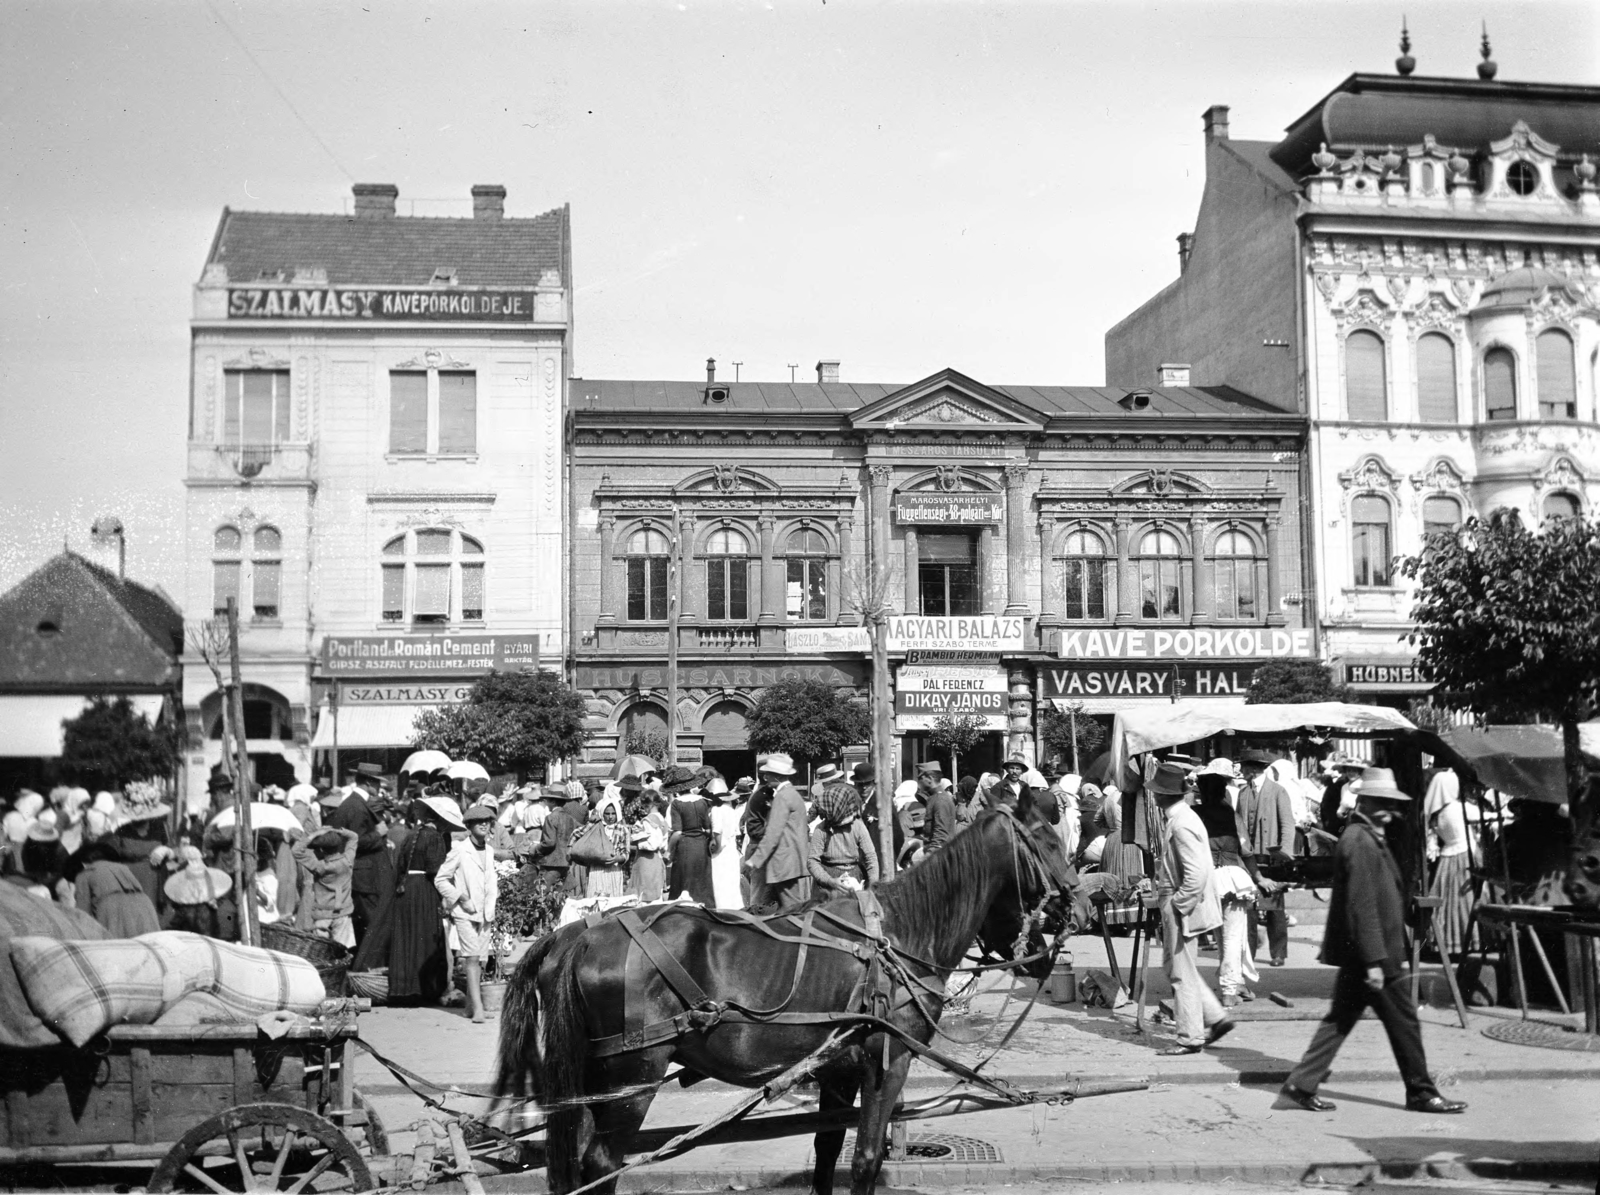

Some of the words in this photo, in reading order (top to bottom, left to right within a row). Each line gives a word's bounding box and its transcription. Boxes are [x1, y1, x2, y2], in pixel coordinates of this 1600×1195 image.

[329, 639, 388, 657] Portland
[394, 639, 441, 656] Román
[443, 638, 495, 655] Cement
[1052, 669, 1169, 694] VASVÁRY
[905, 694, 951, 708] DIKAY
